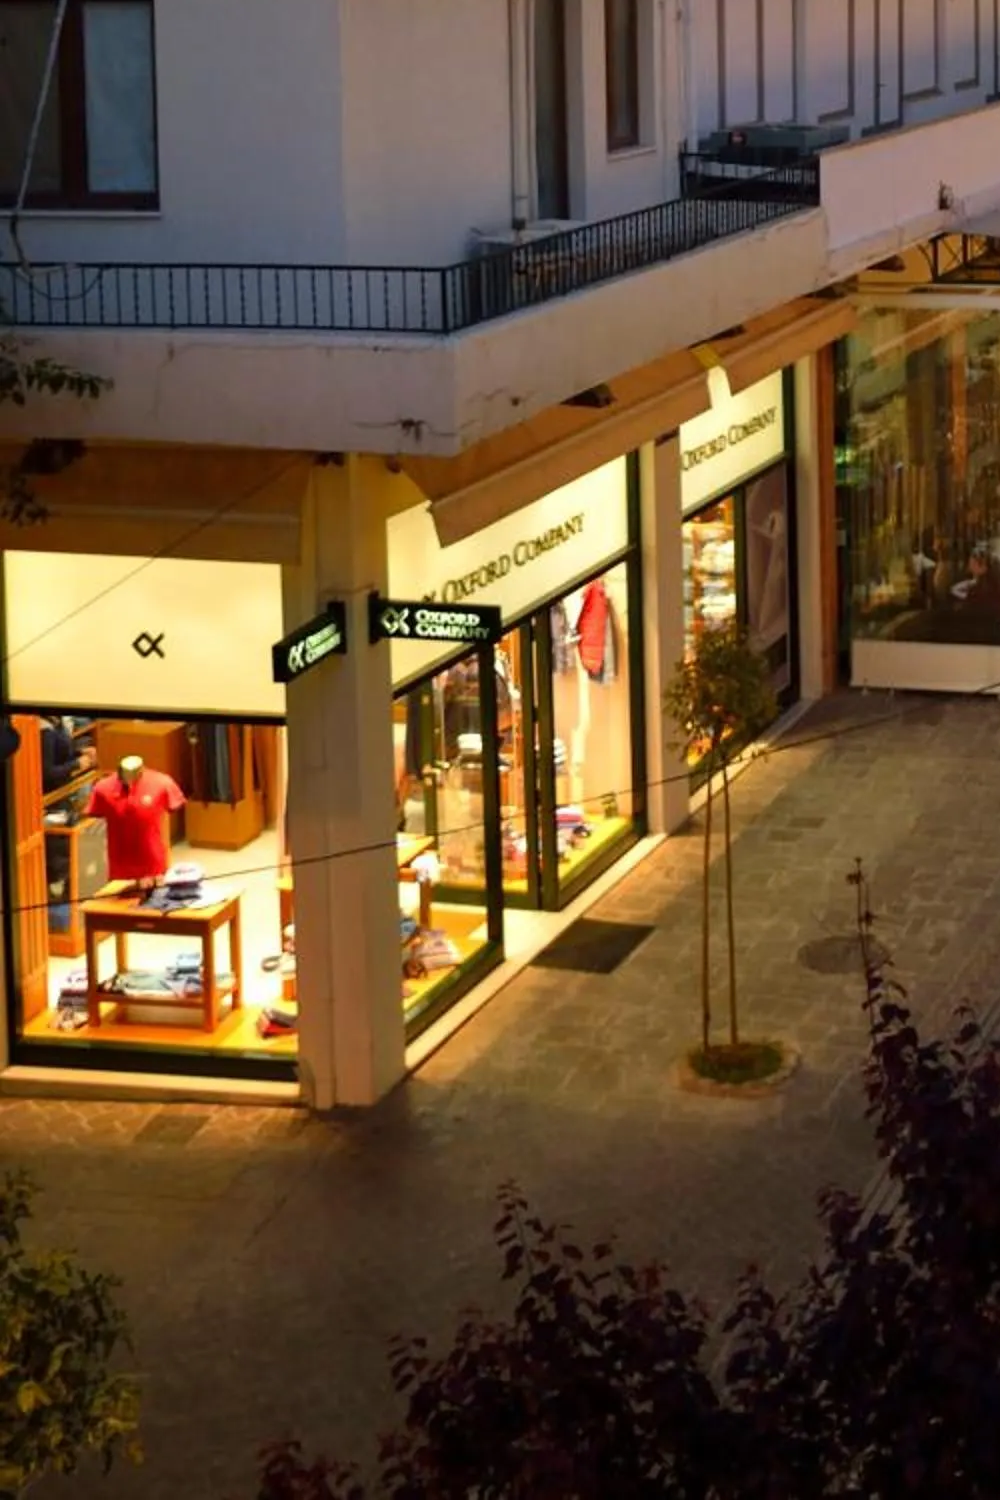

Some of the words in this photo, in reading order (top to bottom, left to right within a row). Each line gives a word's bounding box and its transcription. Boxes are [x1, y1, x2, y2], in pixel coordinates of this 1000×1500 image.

[441, 555, 511, 603] OXFORD
[513, 512, 585, 567] COMPANY
[415, 609, 480, 627] OXFORD
[415, 624, 490, 639] COMPANY
